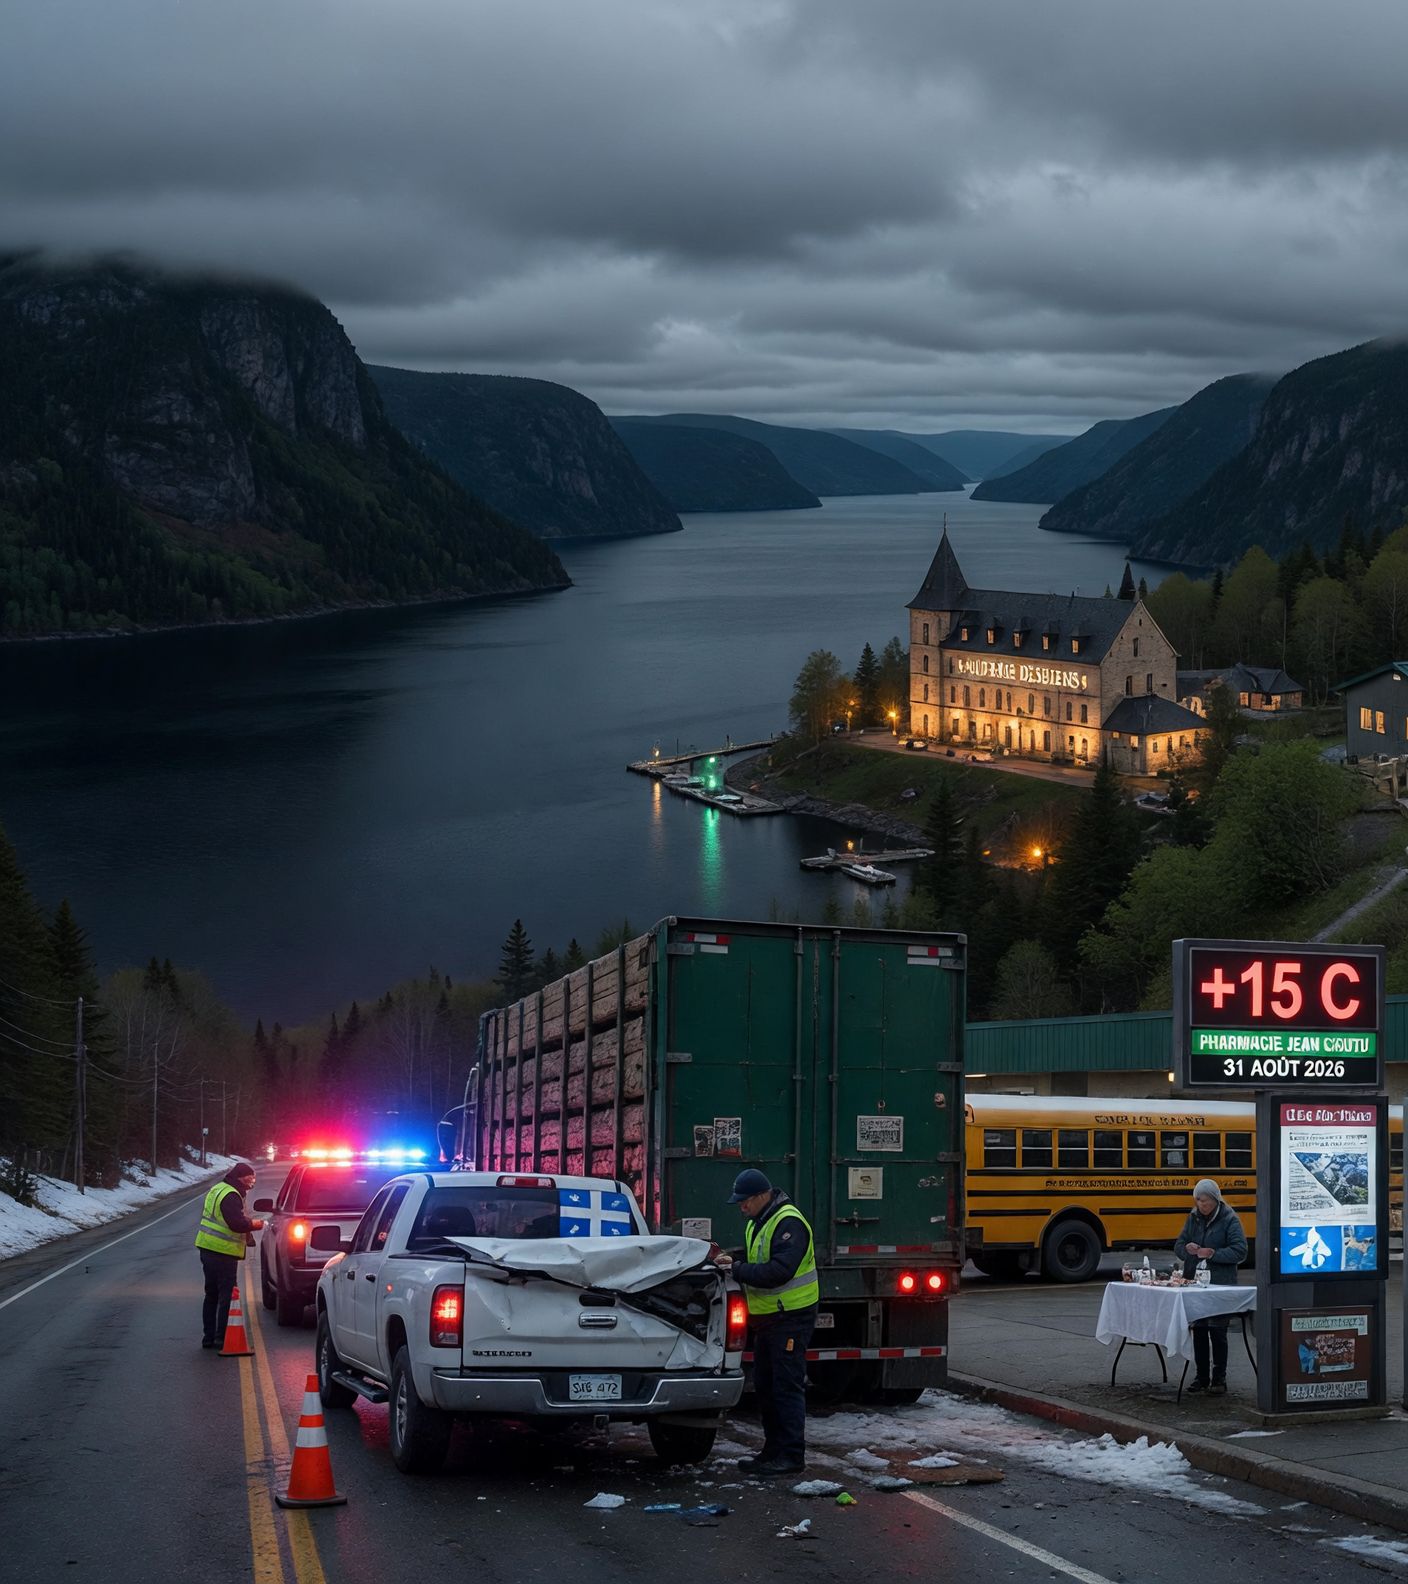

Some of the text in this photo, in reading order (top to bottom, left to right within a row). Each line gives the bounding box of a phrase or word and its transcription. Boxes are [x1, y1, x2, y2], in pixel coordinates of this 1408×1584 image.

[1201, 961, 1360, 1020] +15 C
[1287, 1036, 1320, 1053] JEAN
[1223, 1056, 1346, 1078] 31 AOÛT 2026
